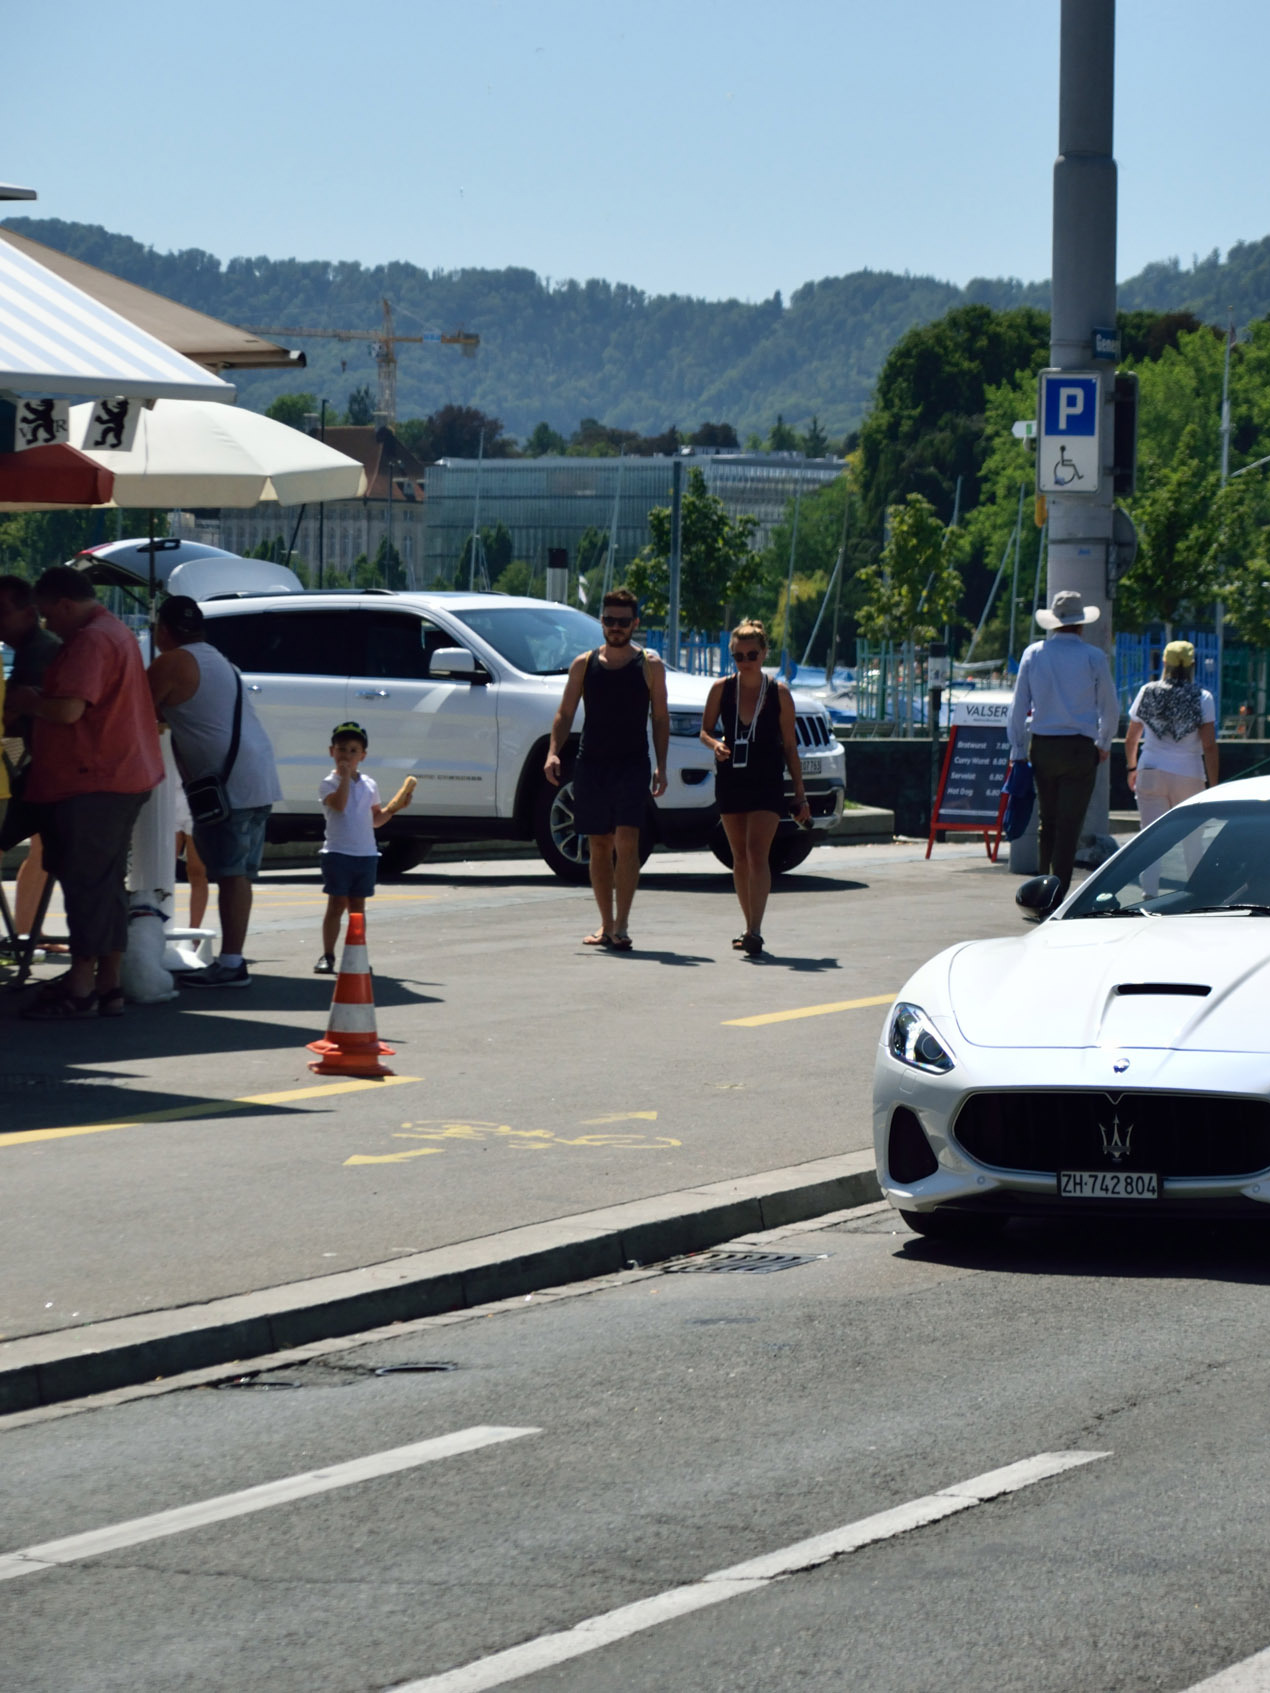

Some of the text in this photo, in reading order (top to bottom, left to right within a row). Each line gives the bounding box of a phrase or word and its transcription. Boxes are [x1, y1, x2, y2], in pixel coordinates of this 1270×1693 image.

[1058, 387, 1084, 430] P
[54, 419, 68, 433] R
[966, 705, 1009, 718] VALSER
[954, 756, 971, 766] Curry
[947, 787, 960, 795] Hot
[960, 787, 974, 797] Dog
